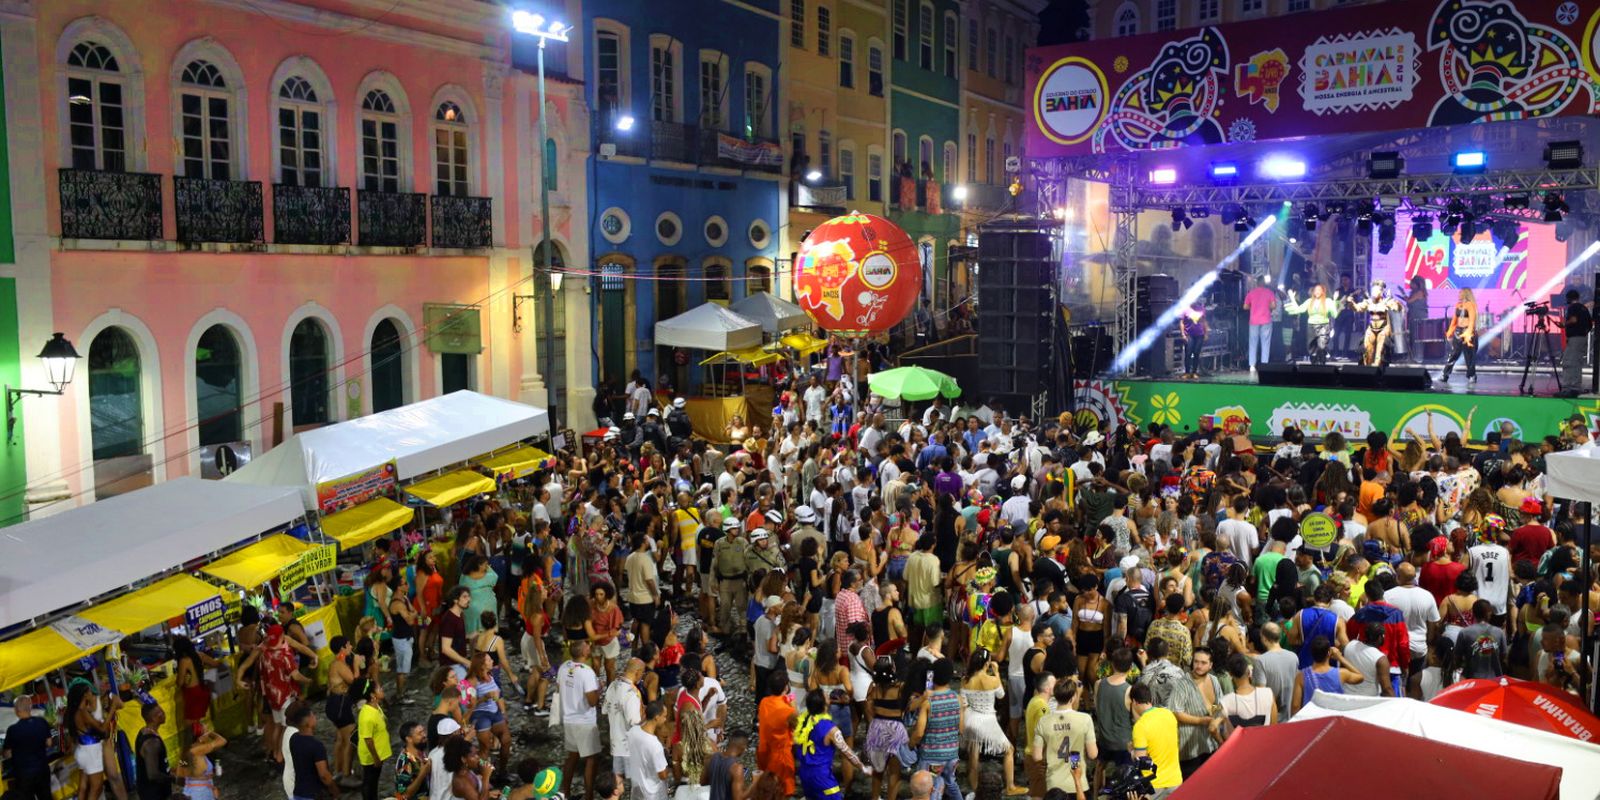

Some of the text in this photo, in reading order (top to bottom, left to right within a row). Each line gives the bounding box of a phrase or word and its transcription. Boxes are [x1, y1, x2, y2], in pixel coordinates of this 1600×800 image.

[1315, 46, 1395, 68] CARNAVAL
[1396, 45, 1404, 82] 2024
[1314, 63, 1394, 92] BAHIA
[1368, 87, 1402, 95] ANCESTRAL
[1046, 94, 1097, 112] BAHIA
[865, 266, 891, 276] BAHIA
[1281, 418, 1352, 433] CARNAVAL
[1481, 551, 1499, 560] ROSE
[1485, 562, 1493, 582] 1
[188, 598, 222, 620] TEMOS
[1054, 723, 1071, 731] ELVIS
[1532, 695, 1592, 742] BRAHMA
[1058, 736, 1070, 763] 4
